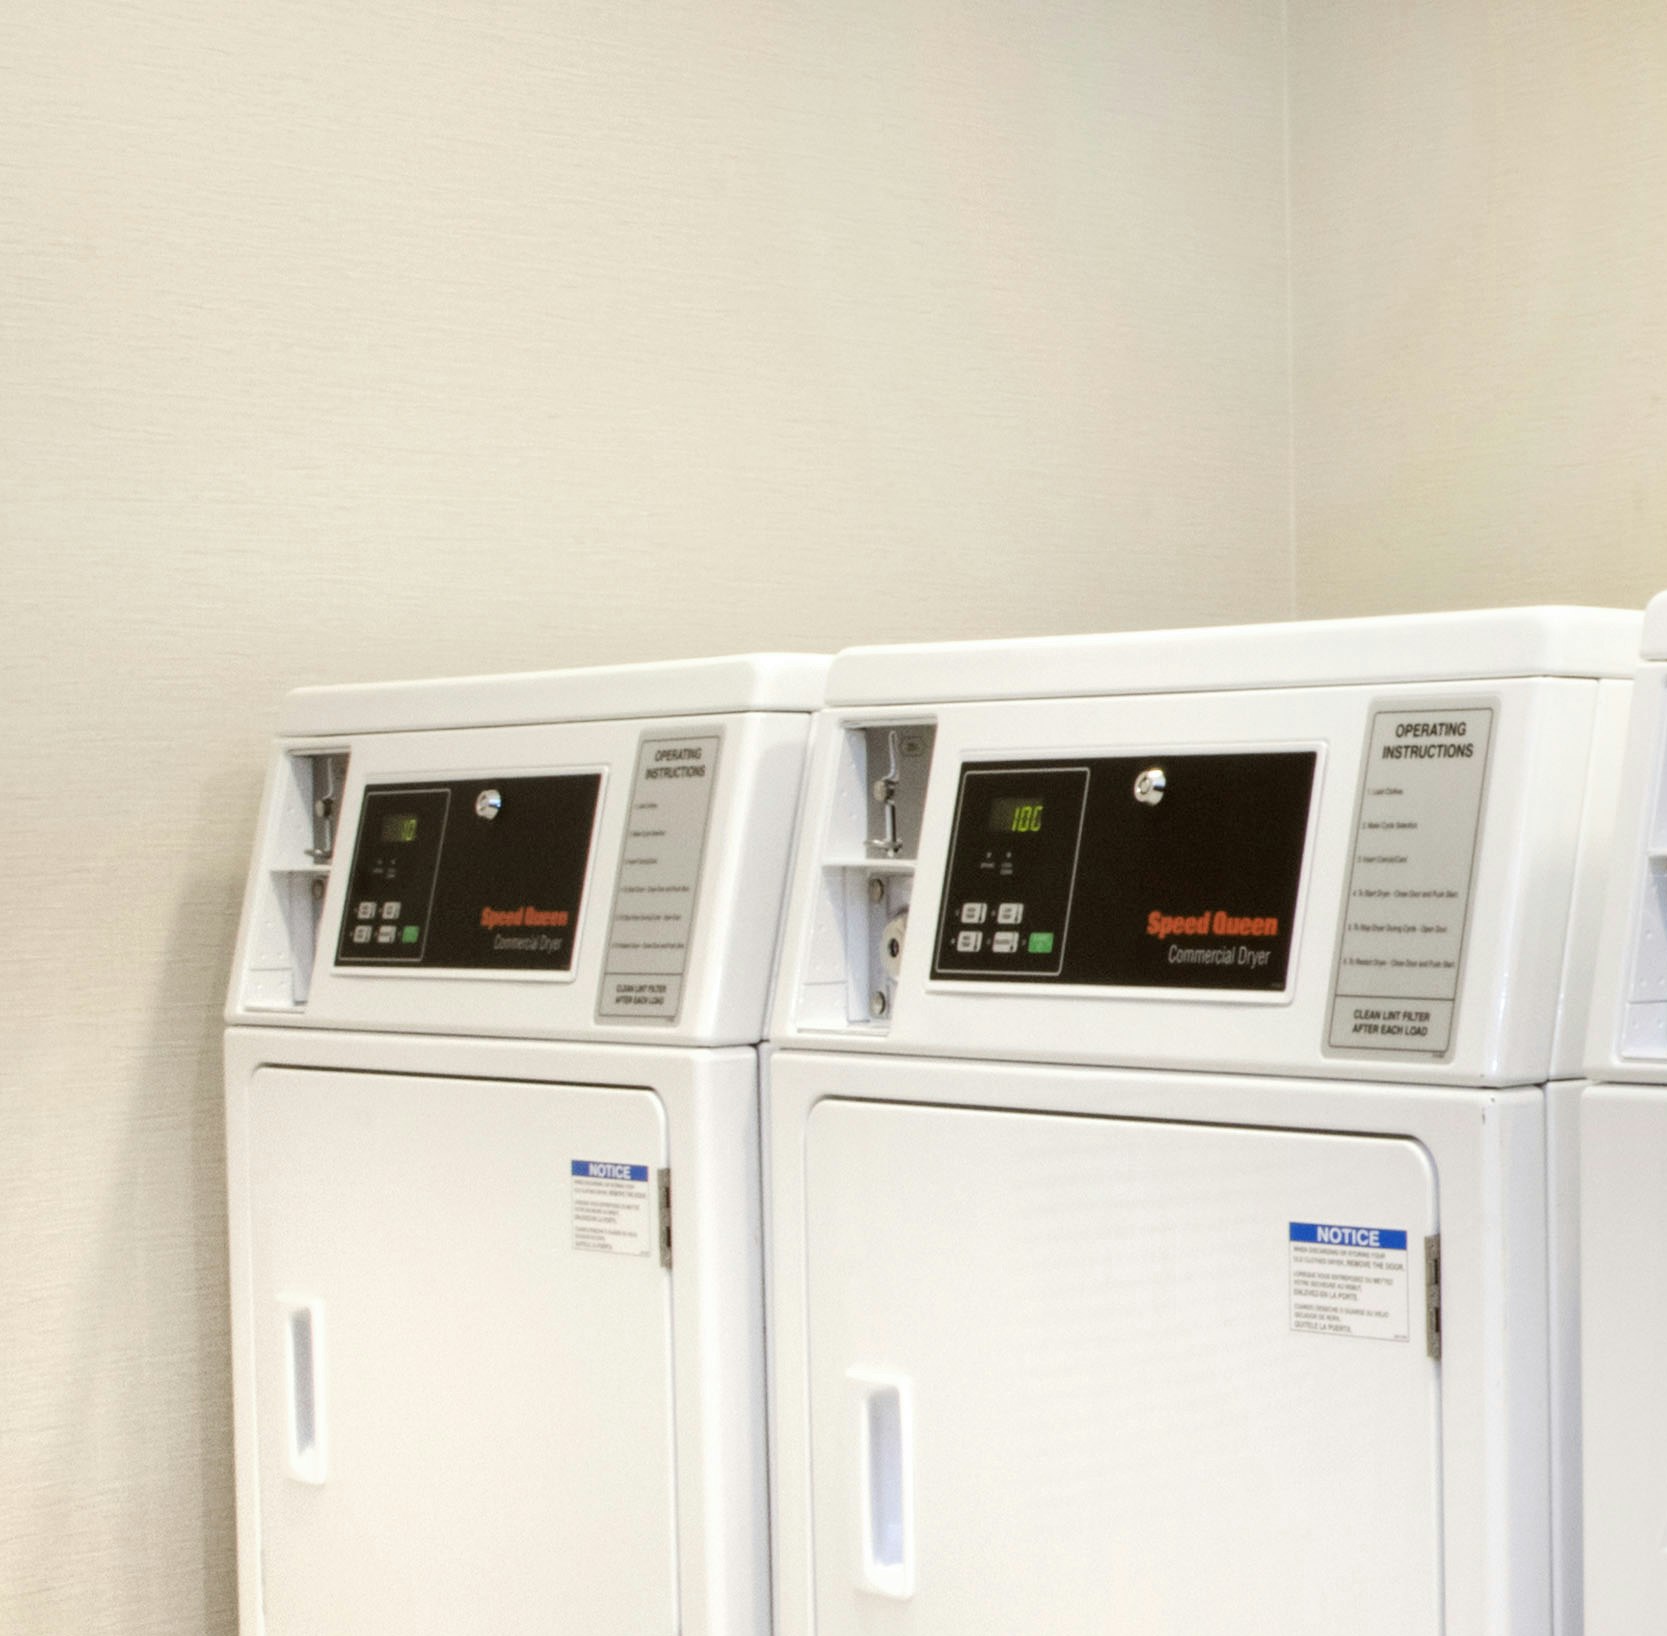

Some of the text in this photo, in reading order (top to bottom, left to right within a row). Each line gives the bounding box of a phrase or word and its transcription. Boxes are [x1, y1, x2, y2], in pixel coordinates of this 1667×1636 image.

[1396, 722, 1466, 738] OPERATING
[654, 748, 702, 761] OPERATING
[1382, 744, 1474, 759] INSTRUCTIONS
[645, 766, 705, 780] INSTRUCTIONS
[481, 906, 568, 929] Speed Queen
[1147, 910, 1278, 939] Speed Queen
[494, 934, 562, 954] Commercial Dryer
[1168, 945, 1270, 967] Commercial Dryer
[1354, 1009, 1430, 1022] CLEAN LINT FILTER
[1352, 1024, 1428, 1036] AFTER EACH LOAD
[589, 1163, 631, 1178] NOTICE
[1317, 1227, 1380, 1246] NOTICE
